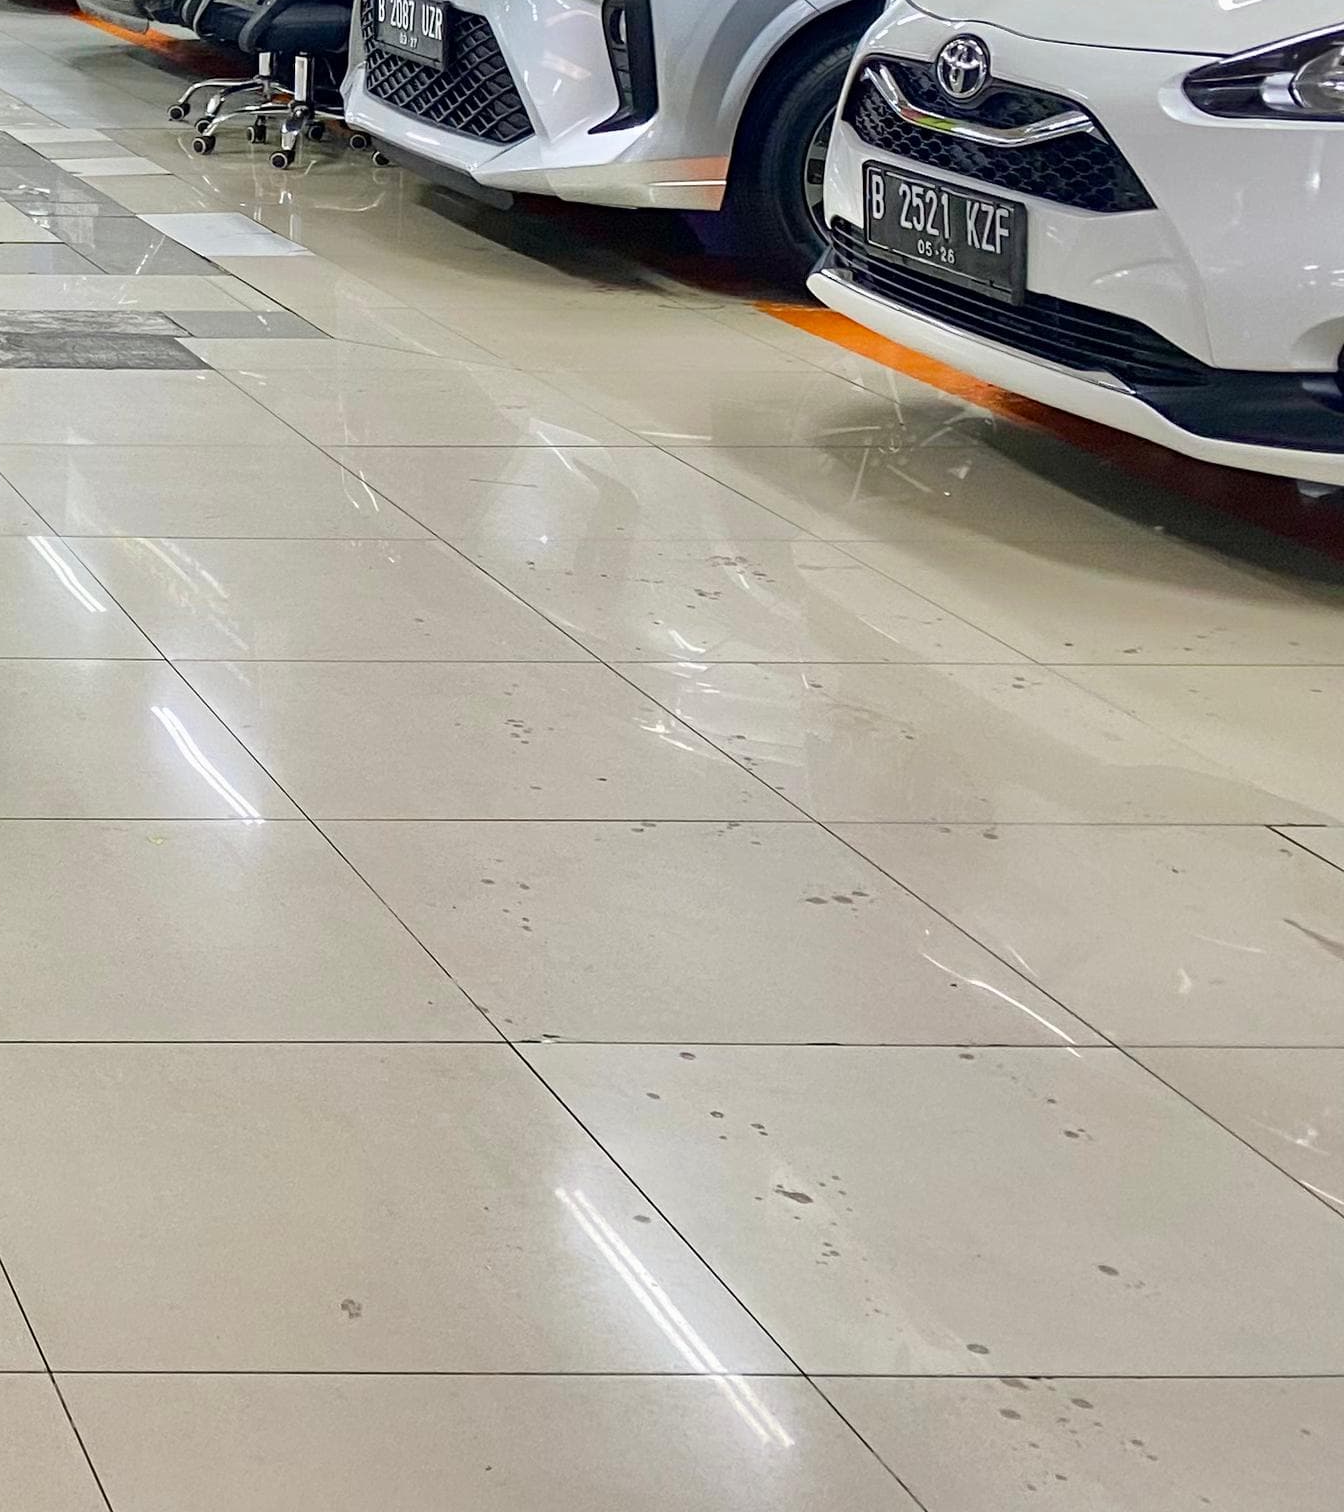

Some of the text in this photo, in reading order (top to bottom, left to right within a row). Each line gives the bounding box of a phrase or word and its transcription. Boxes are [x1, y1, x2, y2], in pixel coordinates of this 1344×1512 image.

[421, 3, 443, 41] UZR
[871, 174, 1010, 255] B 2521 KZF
